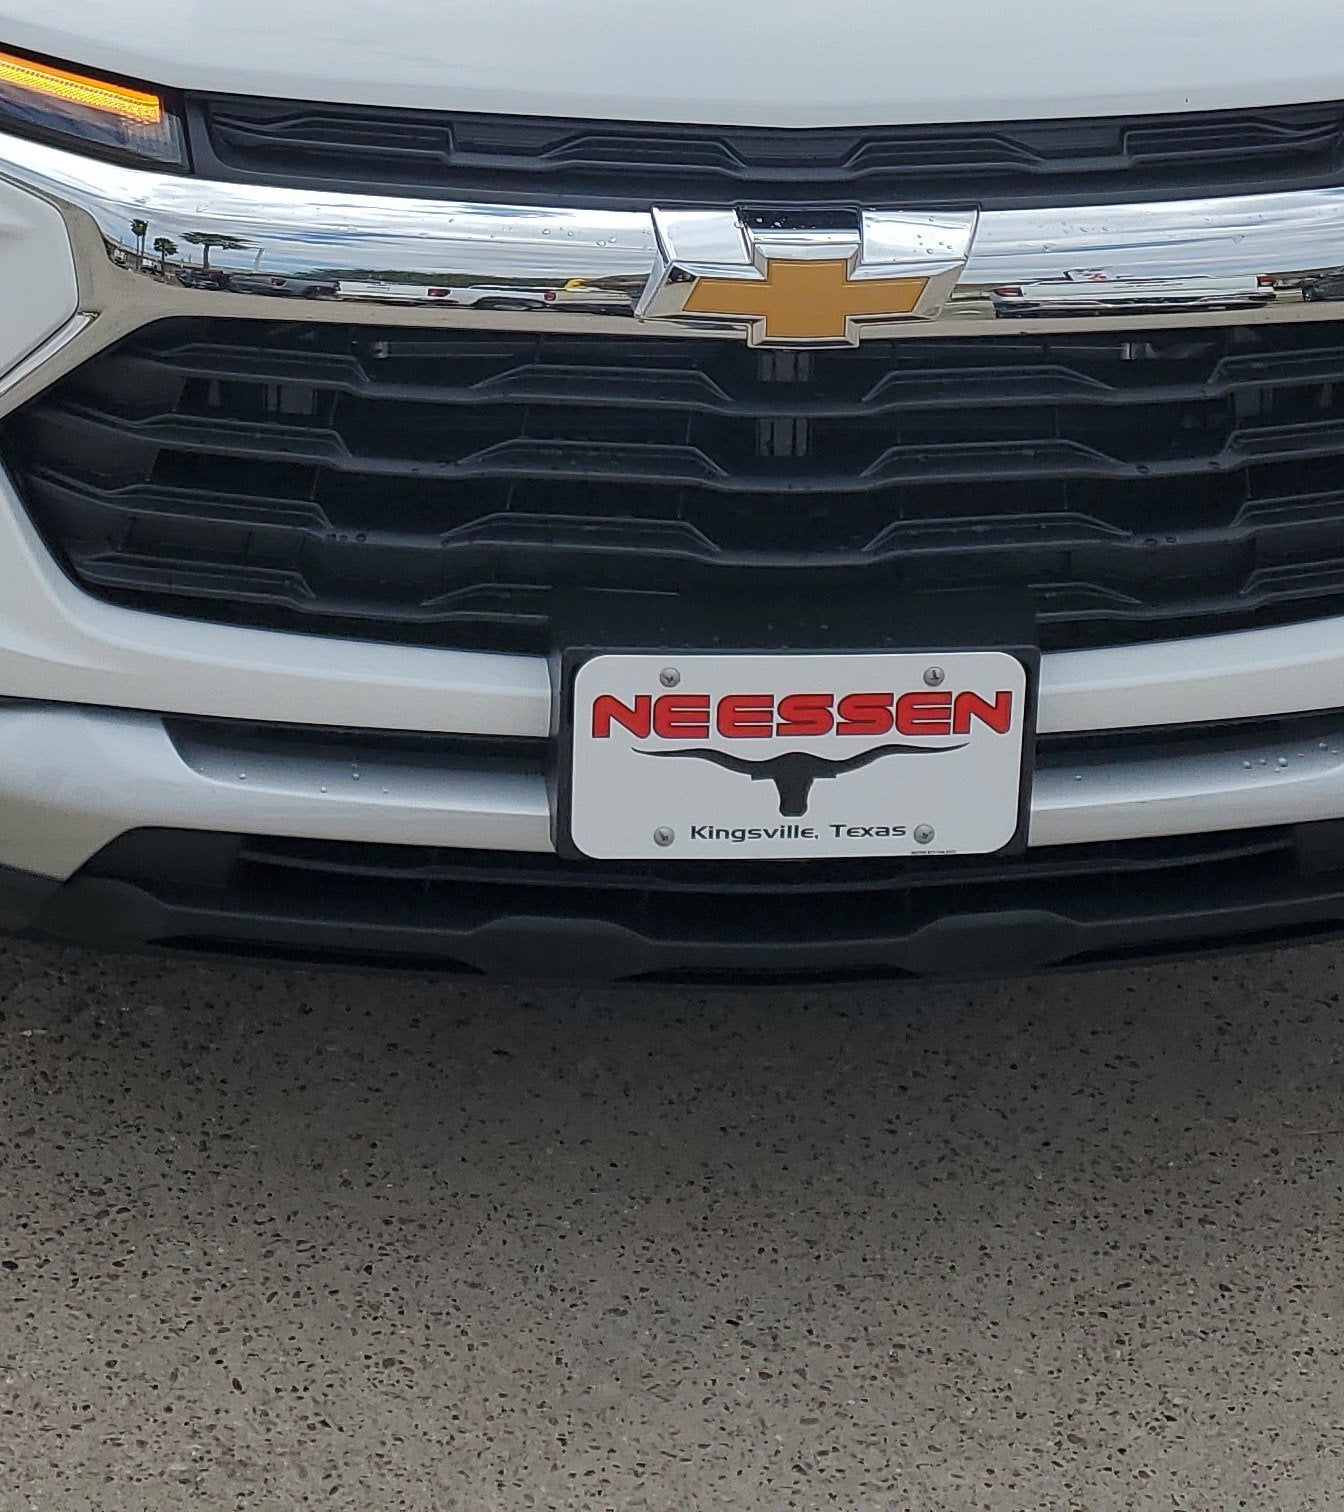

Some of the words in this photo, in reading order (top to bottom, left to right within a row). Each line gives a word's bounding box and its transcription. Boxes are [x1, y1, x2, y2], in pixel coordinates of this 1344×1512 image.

[591, 690, 1013, 739] NEESSEN
[690, 824, 819, 843] Kingsville,
[829, 824, 907, 838] Texas
